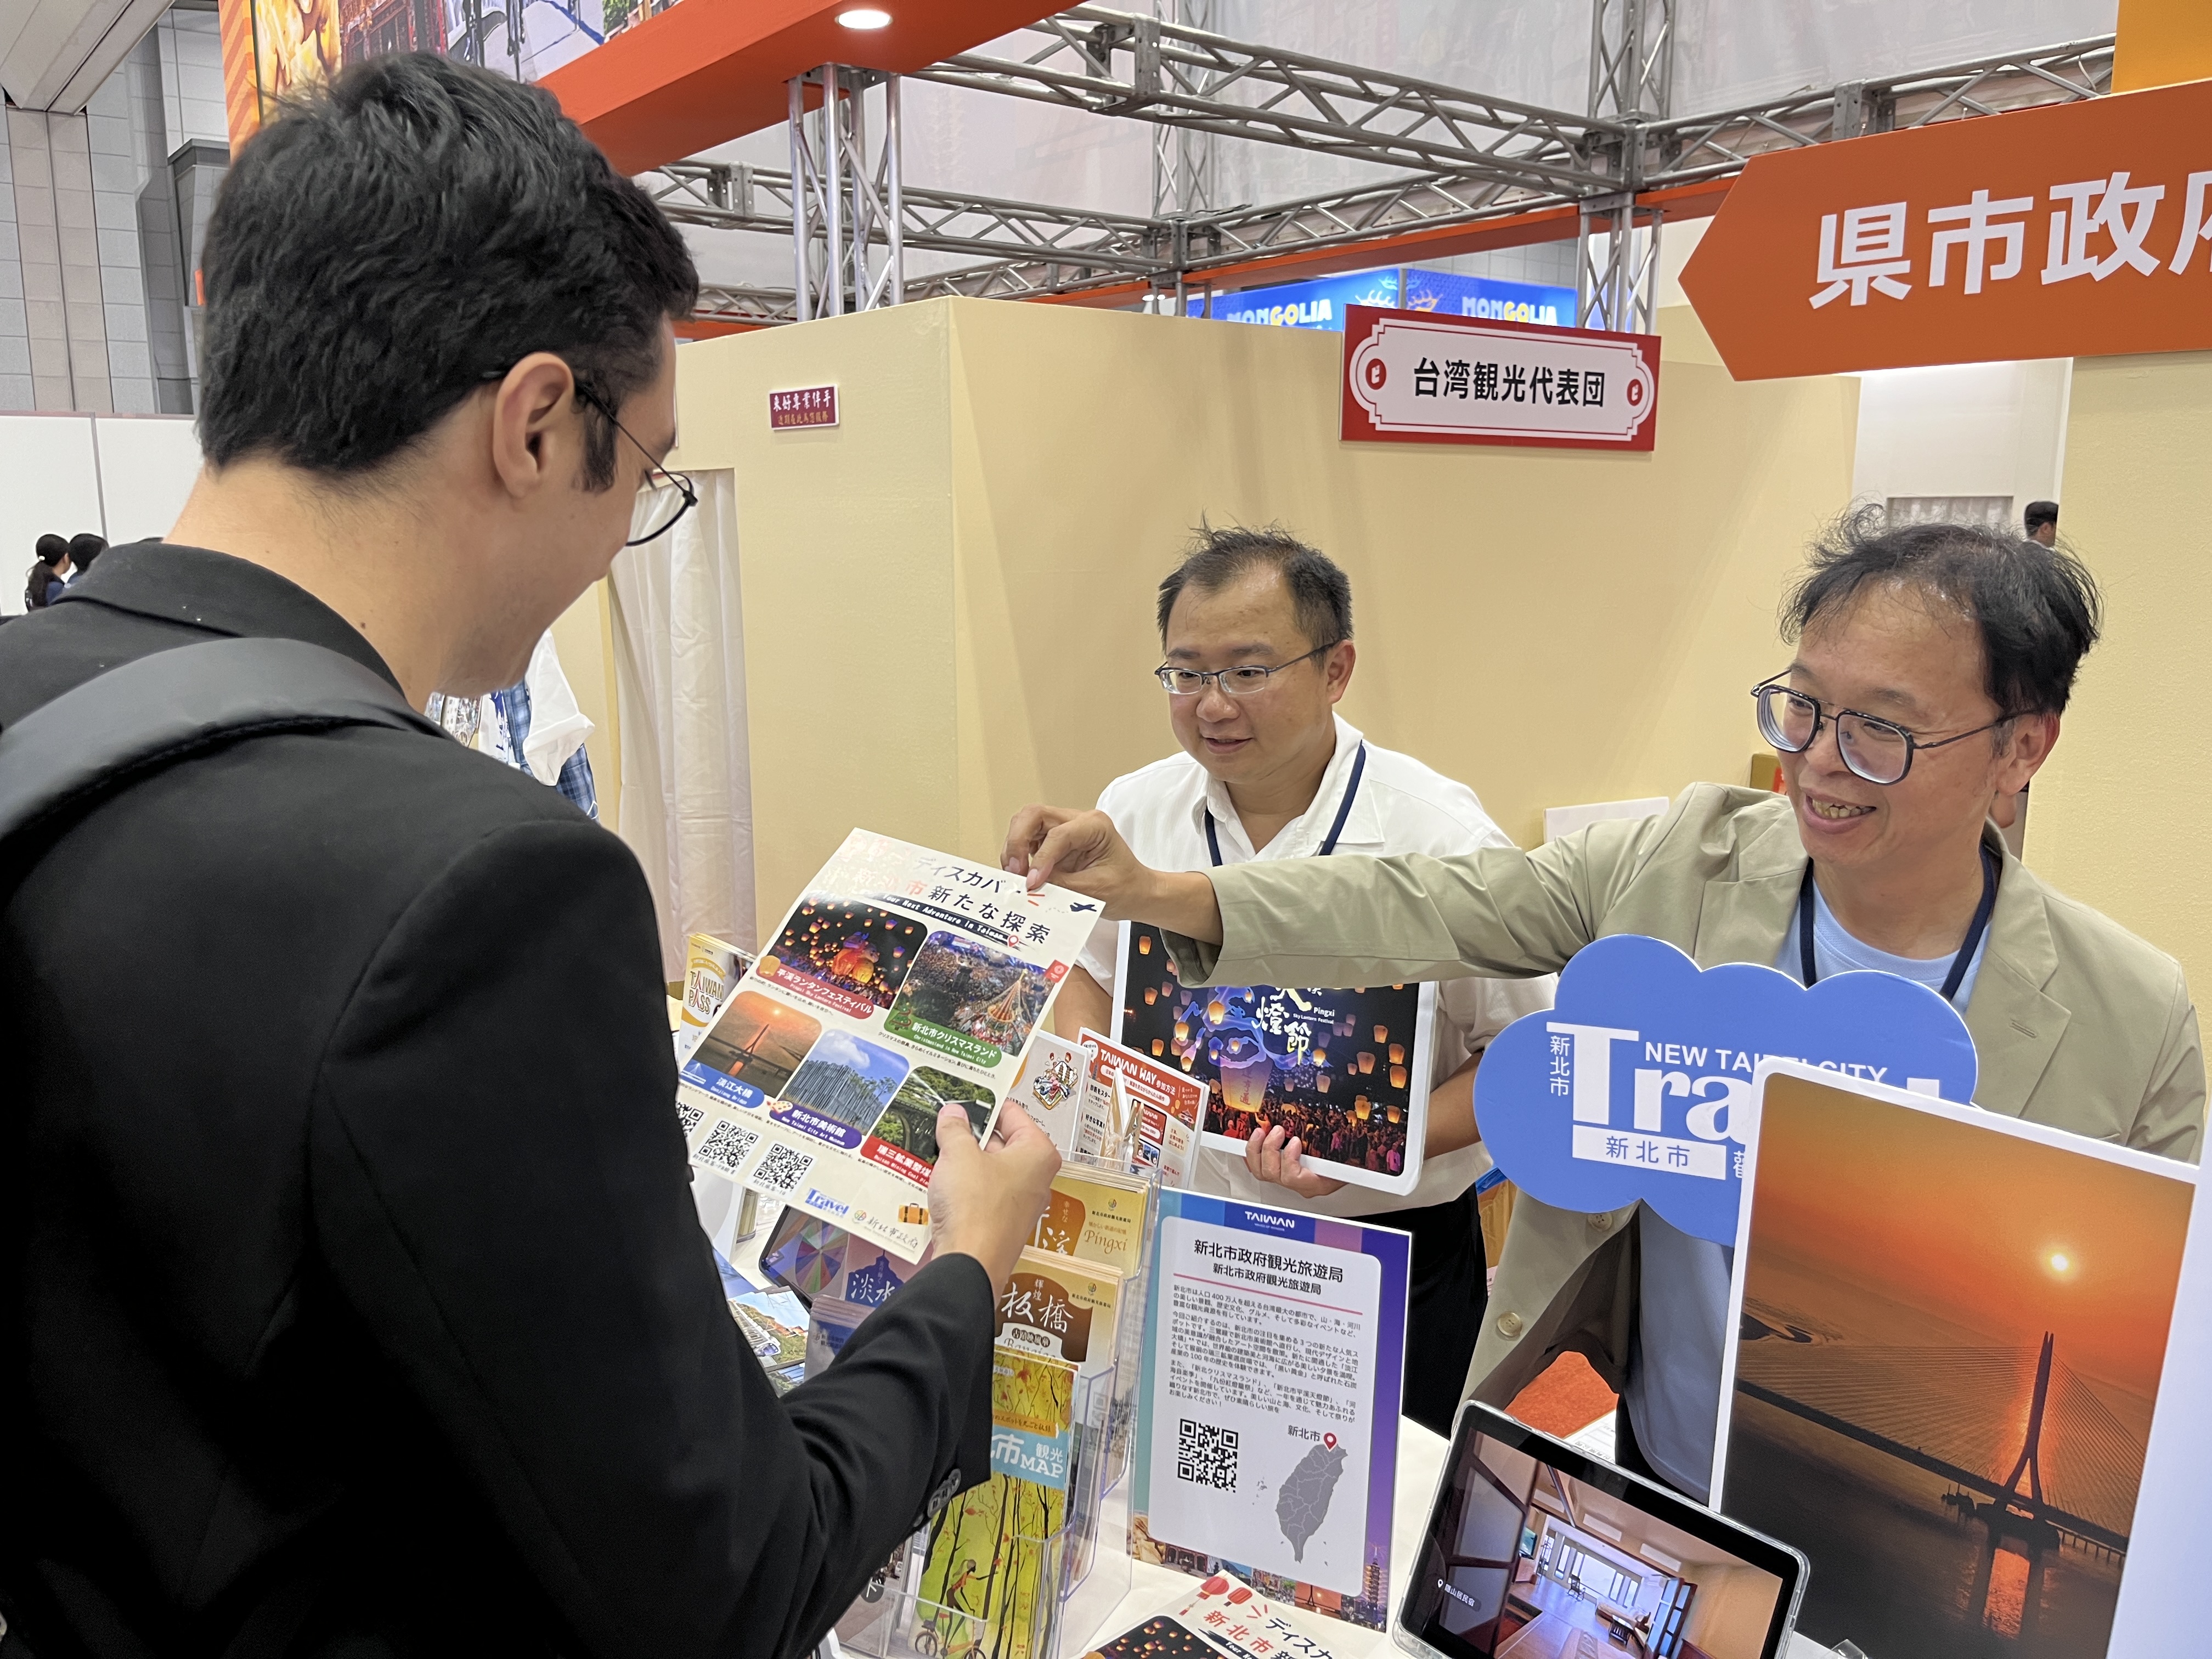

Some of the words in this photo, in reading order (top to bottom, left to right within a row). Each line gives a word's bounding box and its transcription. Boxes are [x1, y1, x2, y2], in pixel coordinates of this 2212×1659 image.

[1462, 296, 1557, 326] MONGOLIA
[1413, 357, 1606, 407] 台湾観光代表団
[902, 900, 920, 910] Next
[923, 906, 961, 925] Adventure
[964, 919, 974, 929] in
[690, 970, 724, 1001] TAIWAN
[689, 989, 710, 1014] PASS
[832, 1000, 852, 1013] Festival
[1313, 1007, 1335, 1017] Pingxi
[911, 1022, 997, 1059] 新北市クリスマスランド
[1101, 1048, 1138, 1076] TAIWAN
[1139, 1067, 1158, 1086] WAY
[1549, 1035, 1571, 1097] 新北市
[1645, 1042, 1708, 1067] NEW
[1715, 1049, 1808, 1073] TAI
[1156, 1080, 1176, 1096] 参加方法
[791, 1109, 847, 1138] 新北市美術館
[820, 1131, 828, 1139] Art
[1606, 1136, 1691, 1168] 新北市
[890, 1163, 907, 1174] Mining
[907, 1171, 919, 1180] Coal
[805, 1187, 849, 1215] Travel
[867, 1216, 918, 1249] 新北市政府
[1244, 1211, 1295, 1228] TAIWAN
[1084, 1229, 1128, 1254] Pingxi
[1194, 1239, 1344, 1283] 新北市政府観光旅遊局
[851, 1273, 895, 1303] 淡水
[1001, 1282, 1074, 1333] 板橋
[1288, 1424, 1321, 1443] 新北市
[1020, 1454, 1063, 1478] MAP
[1036, 1442, 1063, 1464] 観光
[1226, 1641, 1242, 1655] Your
